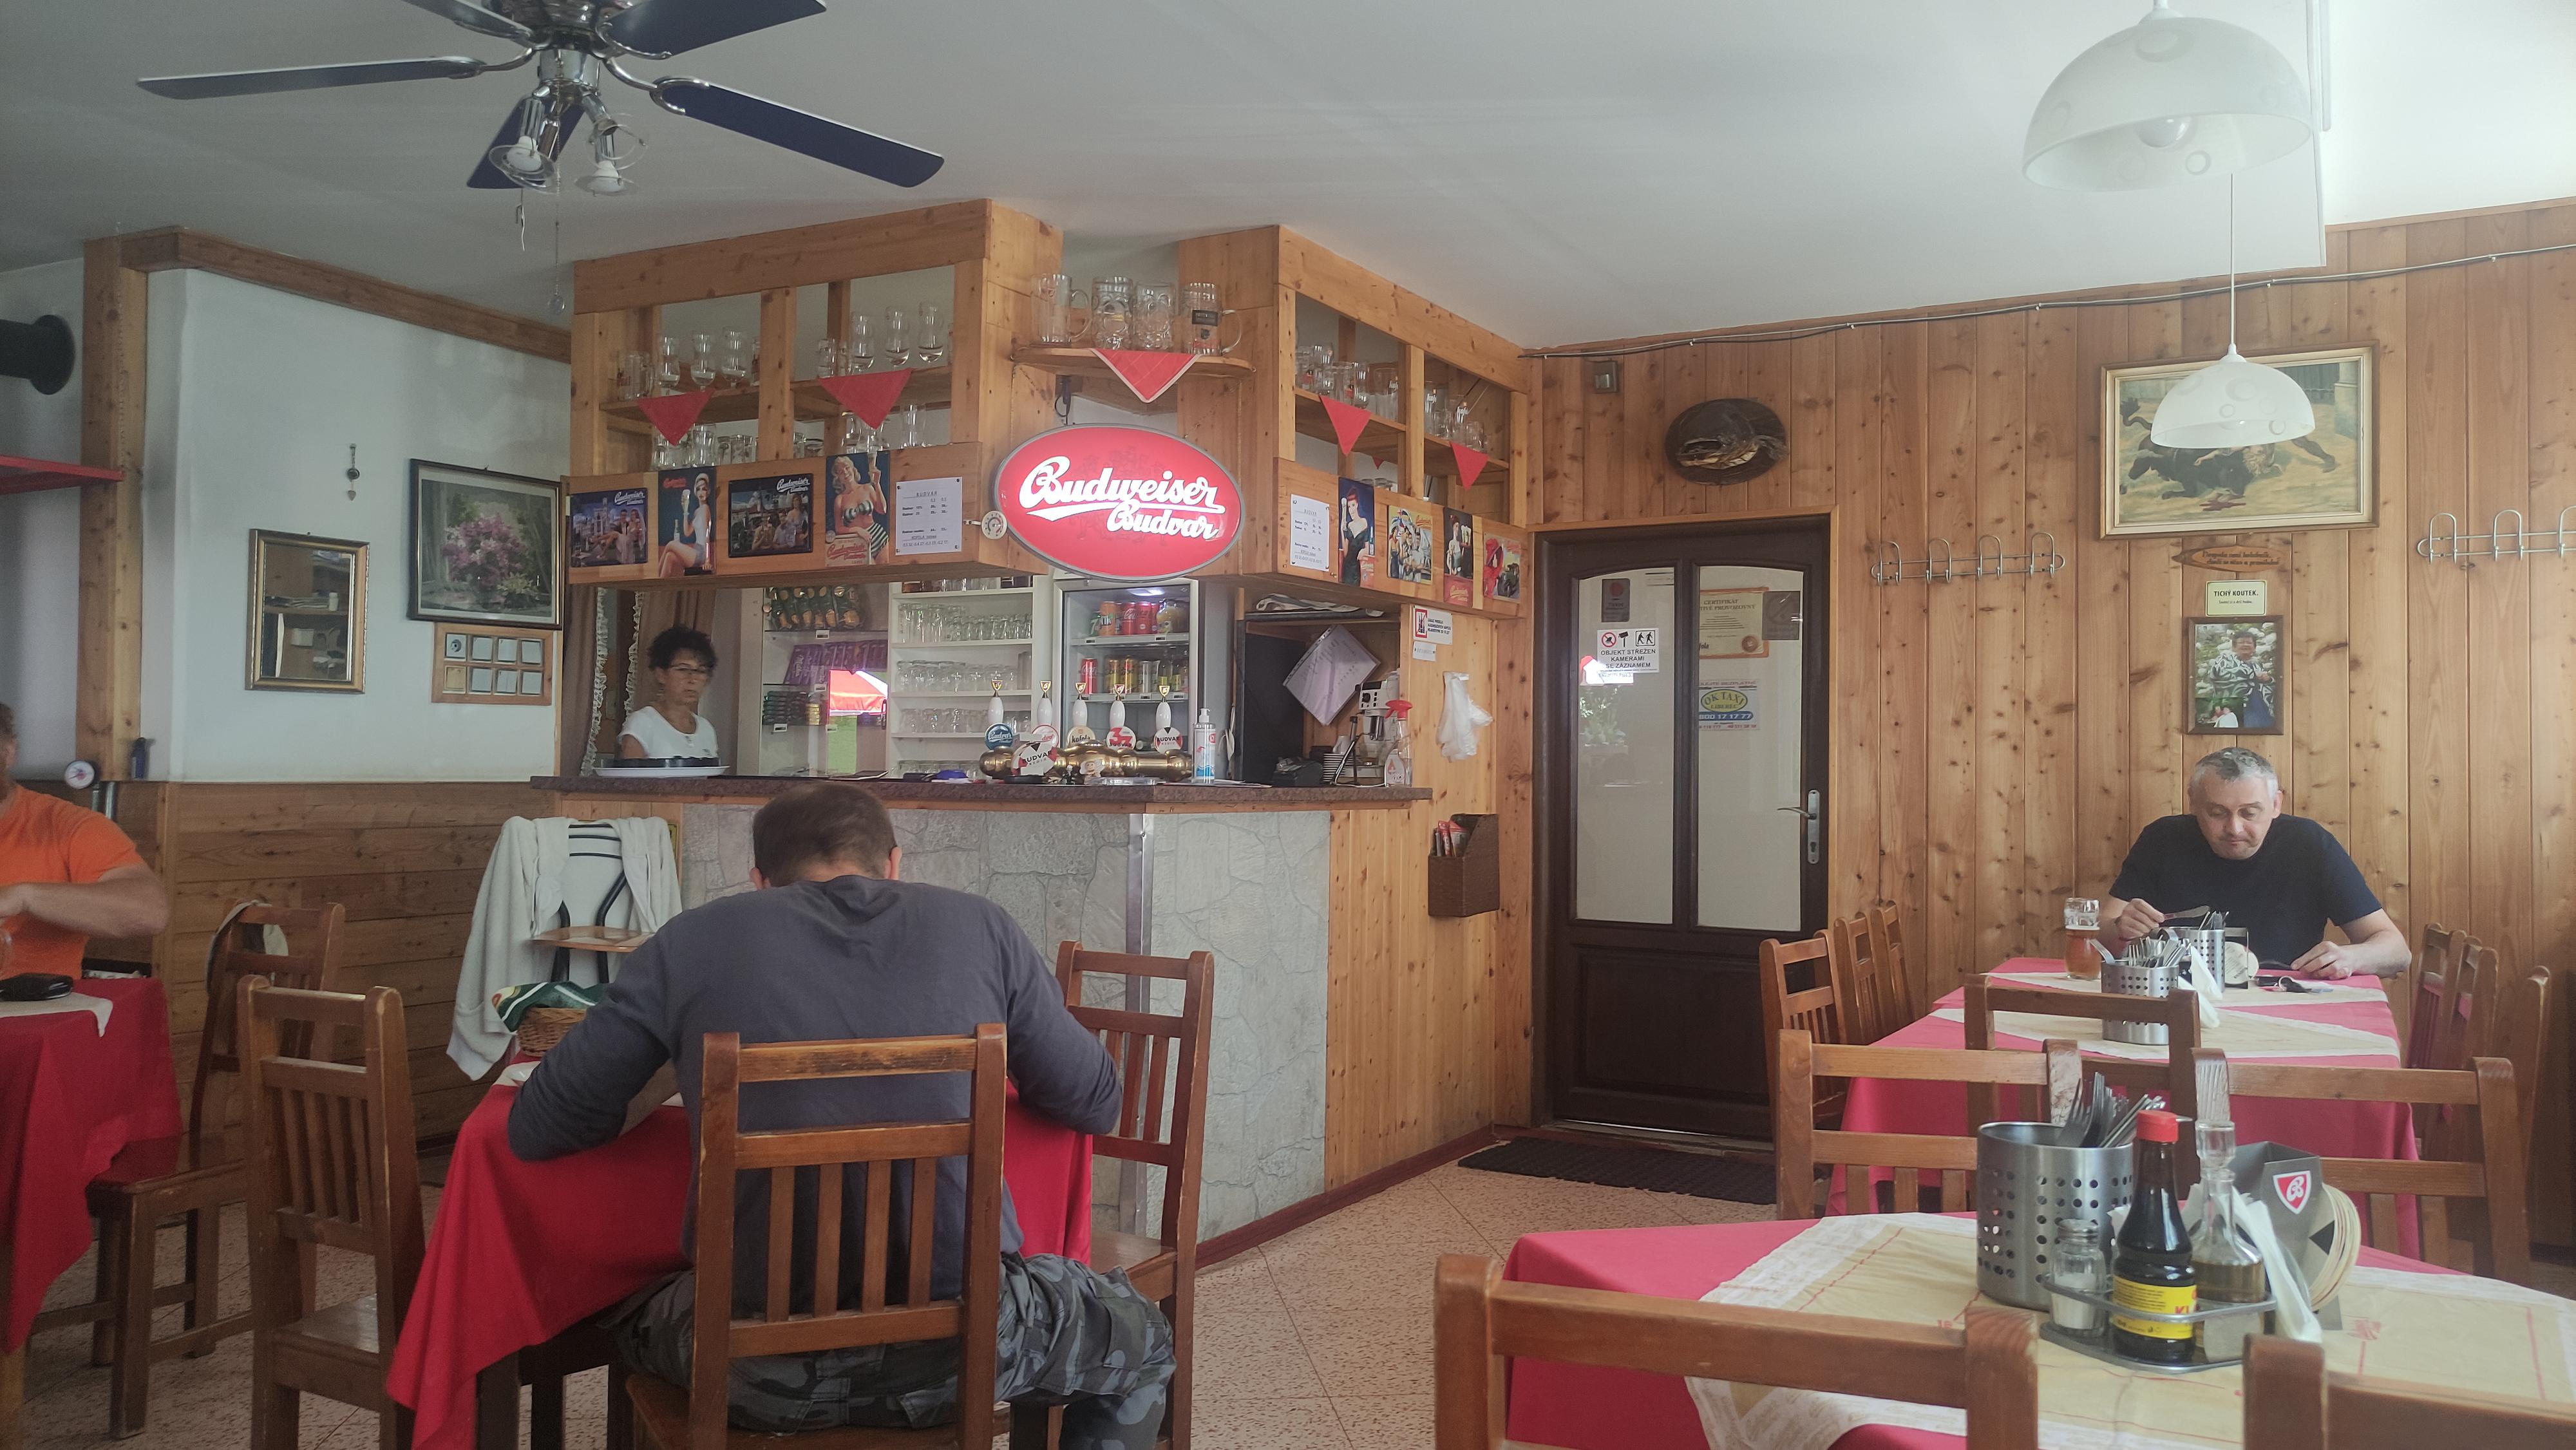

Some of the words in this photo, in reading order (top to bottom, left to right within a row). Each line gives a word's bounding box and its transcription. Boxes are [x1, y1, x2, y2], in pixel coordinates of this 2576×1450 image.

[1019, 455, 1226, 514] Budweiser
[1106, 498, 1219, 540] Budvar
[1704, 693, 1719, 705] OK
[1721, 692, 1745, 705] TAXI
